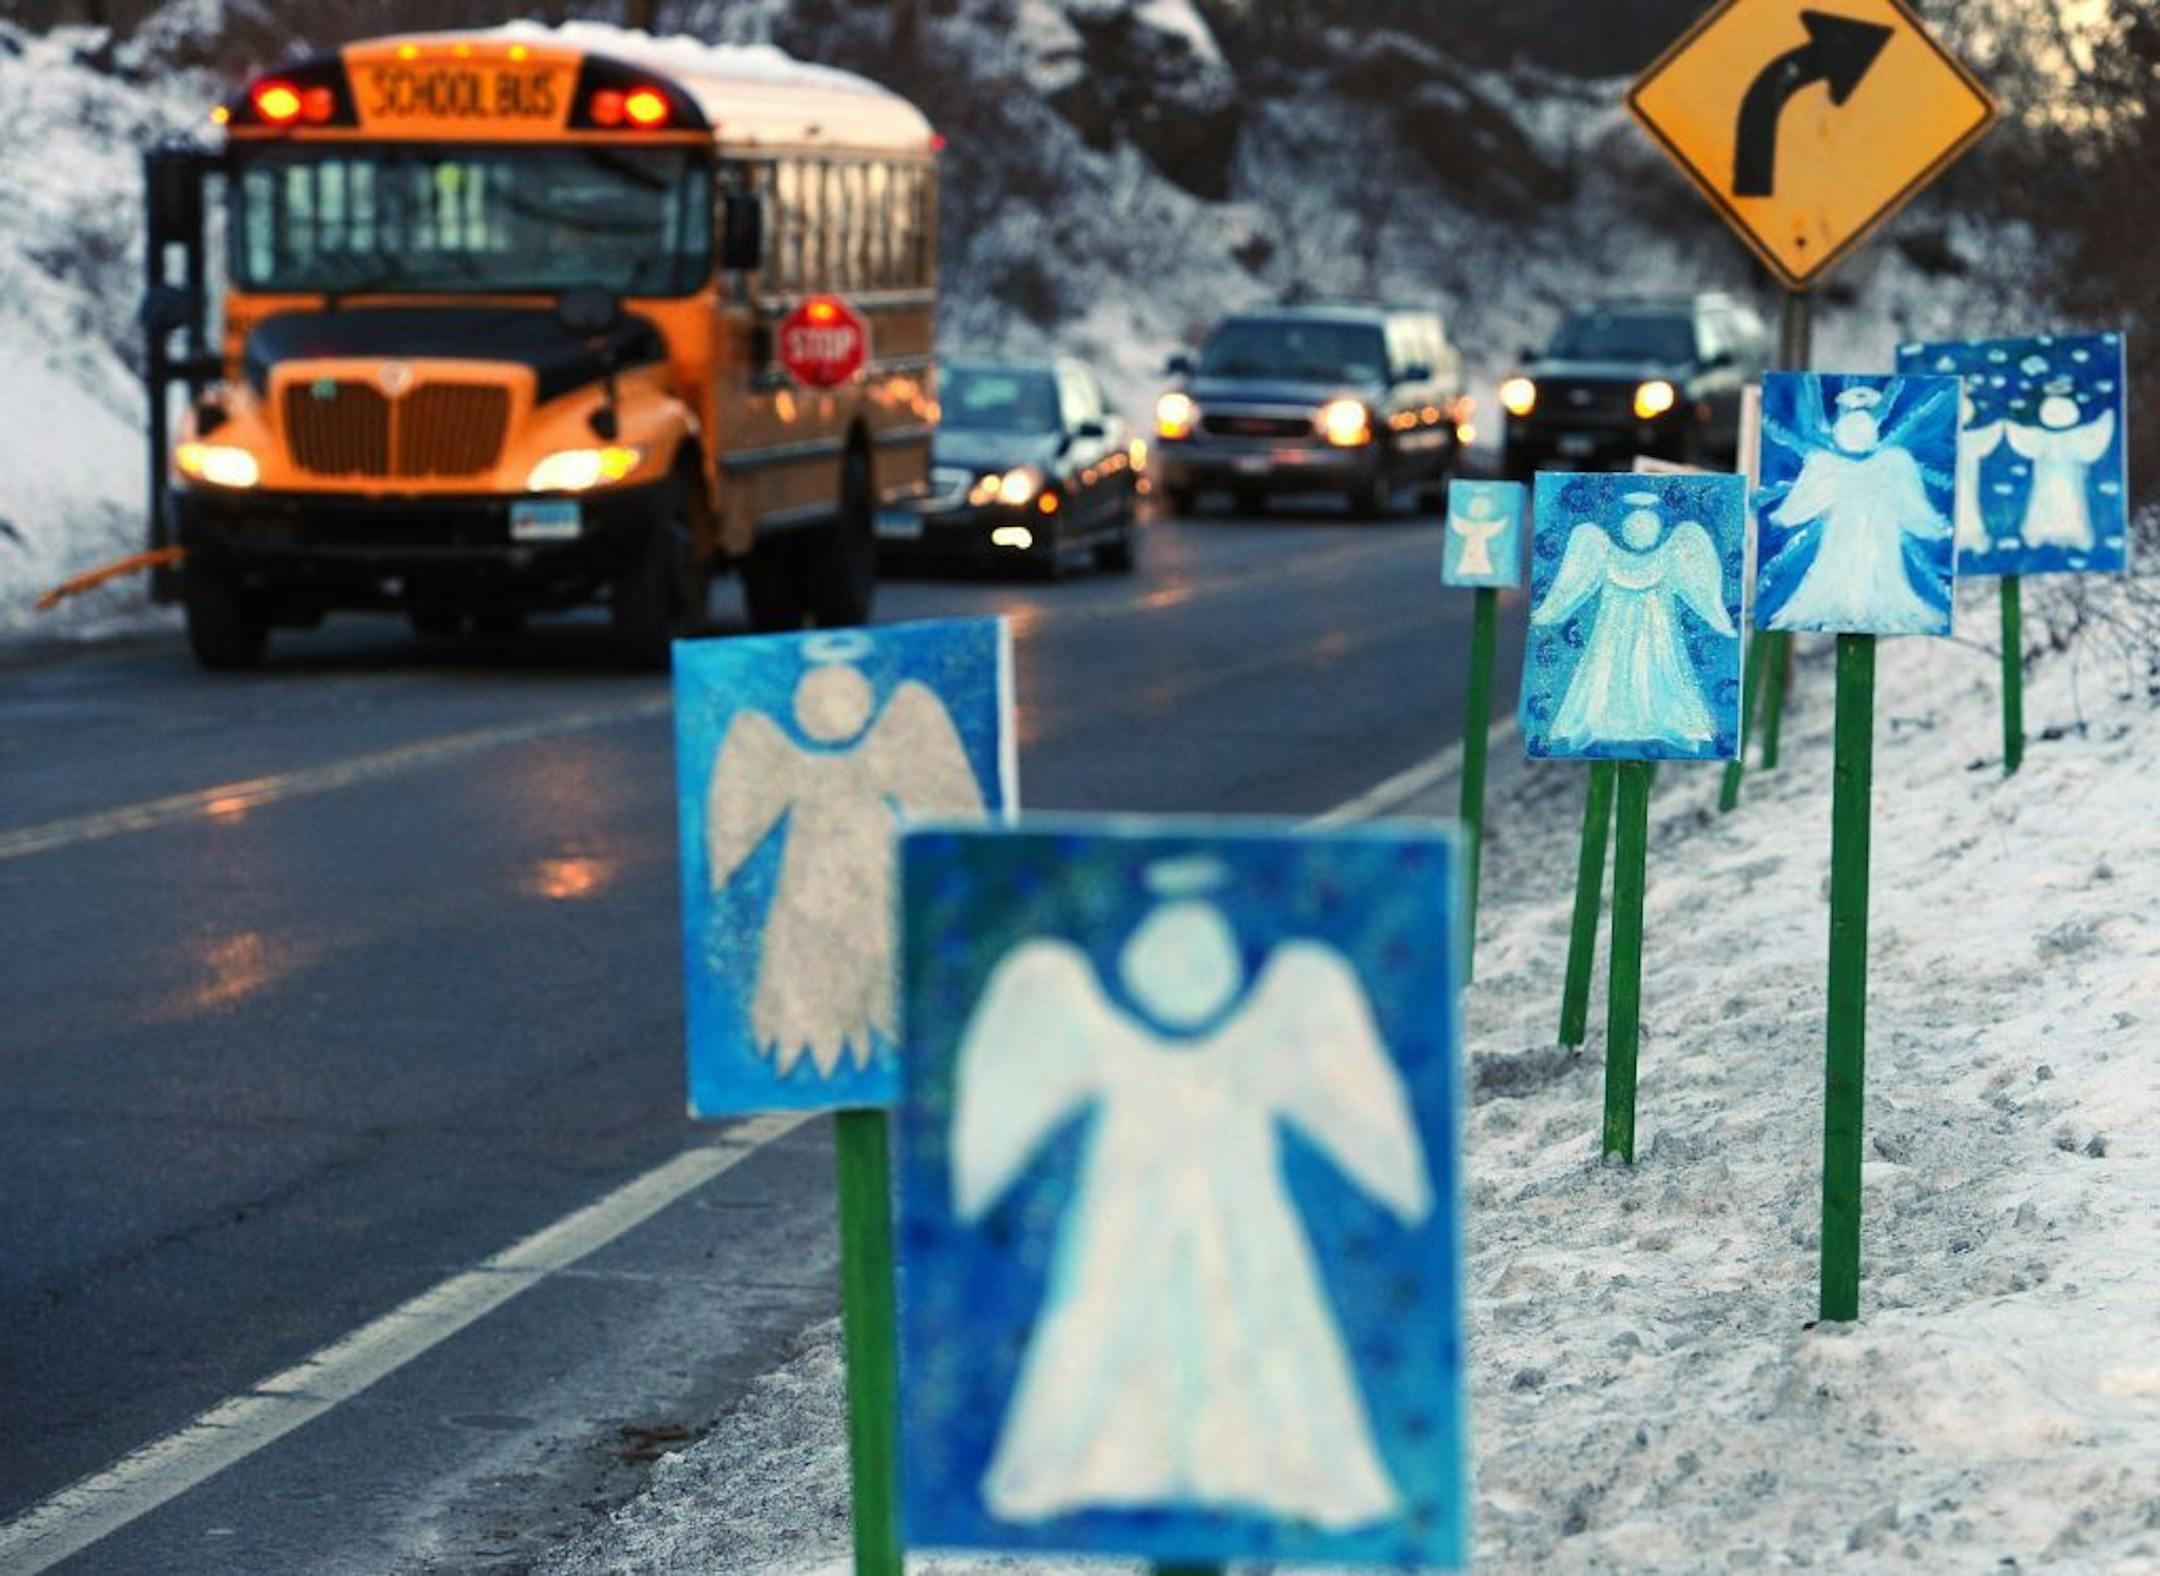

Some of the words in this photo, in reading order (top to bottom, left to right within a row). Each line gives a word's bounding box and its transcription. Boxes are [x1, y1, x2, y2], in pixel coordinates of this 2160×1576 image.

[370, 67, 491, 119] SCHOOL
[496, 67, 557, 119] BUS
[786, 326, 857, 362] STOP
